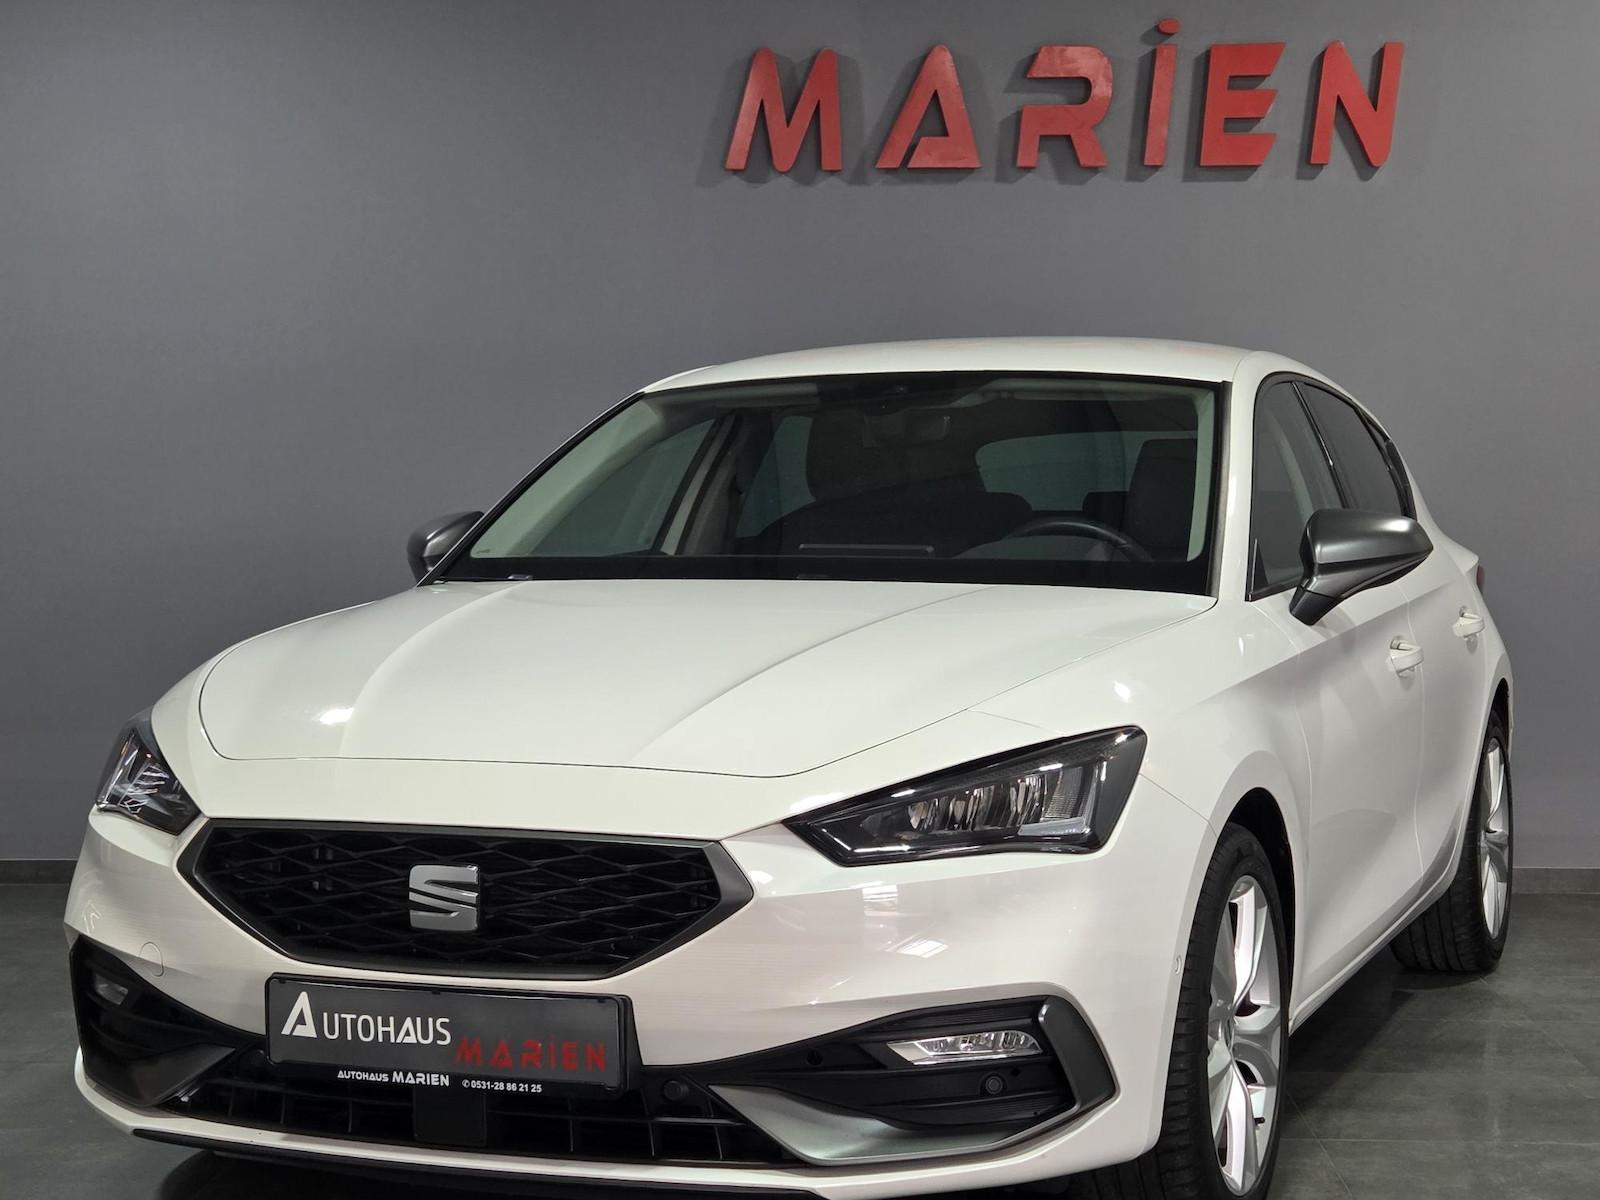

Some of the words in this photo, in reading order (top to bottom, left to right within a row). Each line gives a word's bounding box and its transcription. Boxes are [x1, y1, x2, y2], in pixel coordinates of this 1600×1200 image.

[280, 990, 452, 1045] AUTOHAUS
[336, 1069, 389, 1082] AUTOHAUS
[391, 1071, 450, 1087] MARIEN
[470, 1080, 505, 1091] 0531-28
[506, 1083, 517, 1092] 86
[518, 1084, 529, 1092] 21
[530, 1084, 542, 1093] 25
